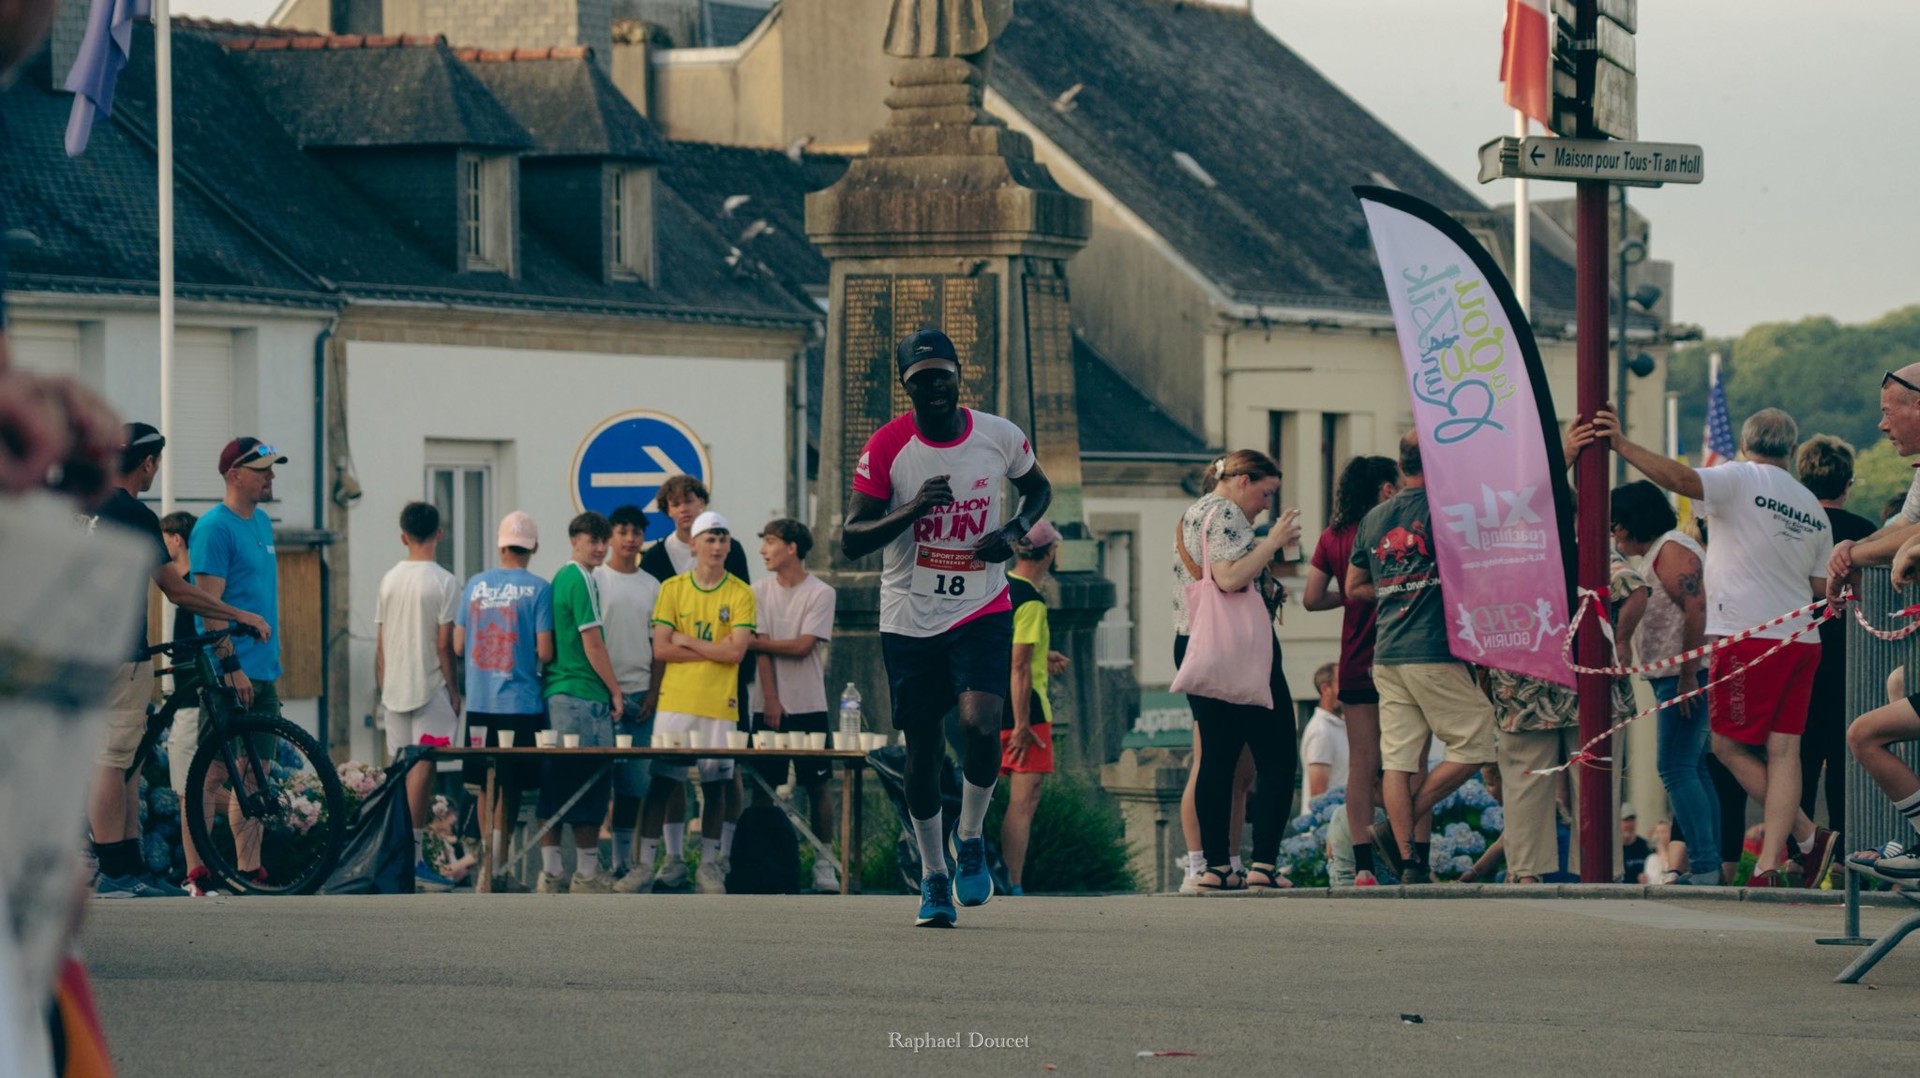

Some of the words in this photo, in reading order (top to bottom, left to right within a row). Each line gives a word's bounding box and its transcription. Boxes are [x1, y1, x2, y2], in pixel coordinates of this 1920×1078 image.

[1554, 147, 1593, 168] Maison
[1595, 155, 1620, 173] pour
[1664, 157, 1677, 172] an
[1680, 154, 1700, 174] Holl
[914, 510, 988, 543] RUN
[931, 552, 955, 560] SPORT
[934, 574, 965, 596] 18
[694, 620, 713, 642] 14
